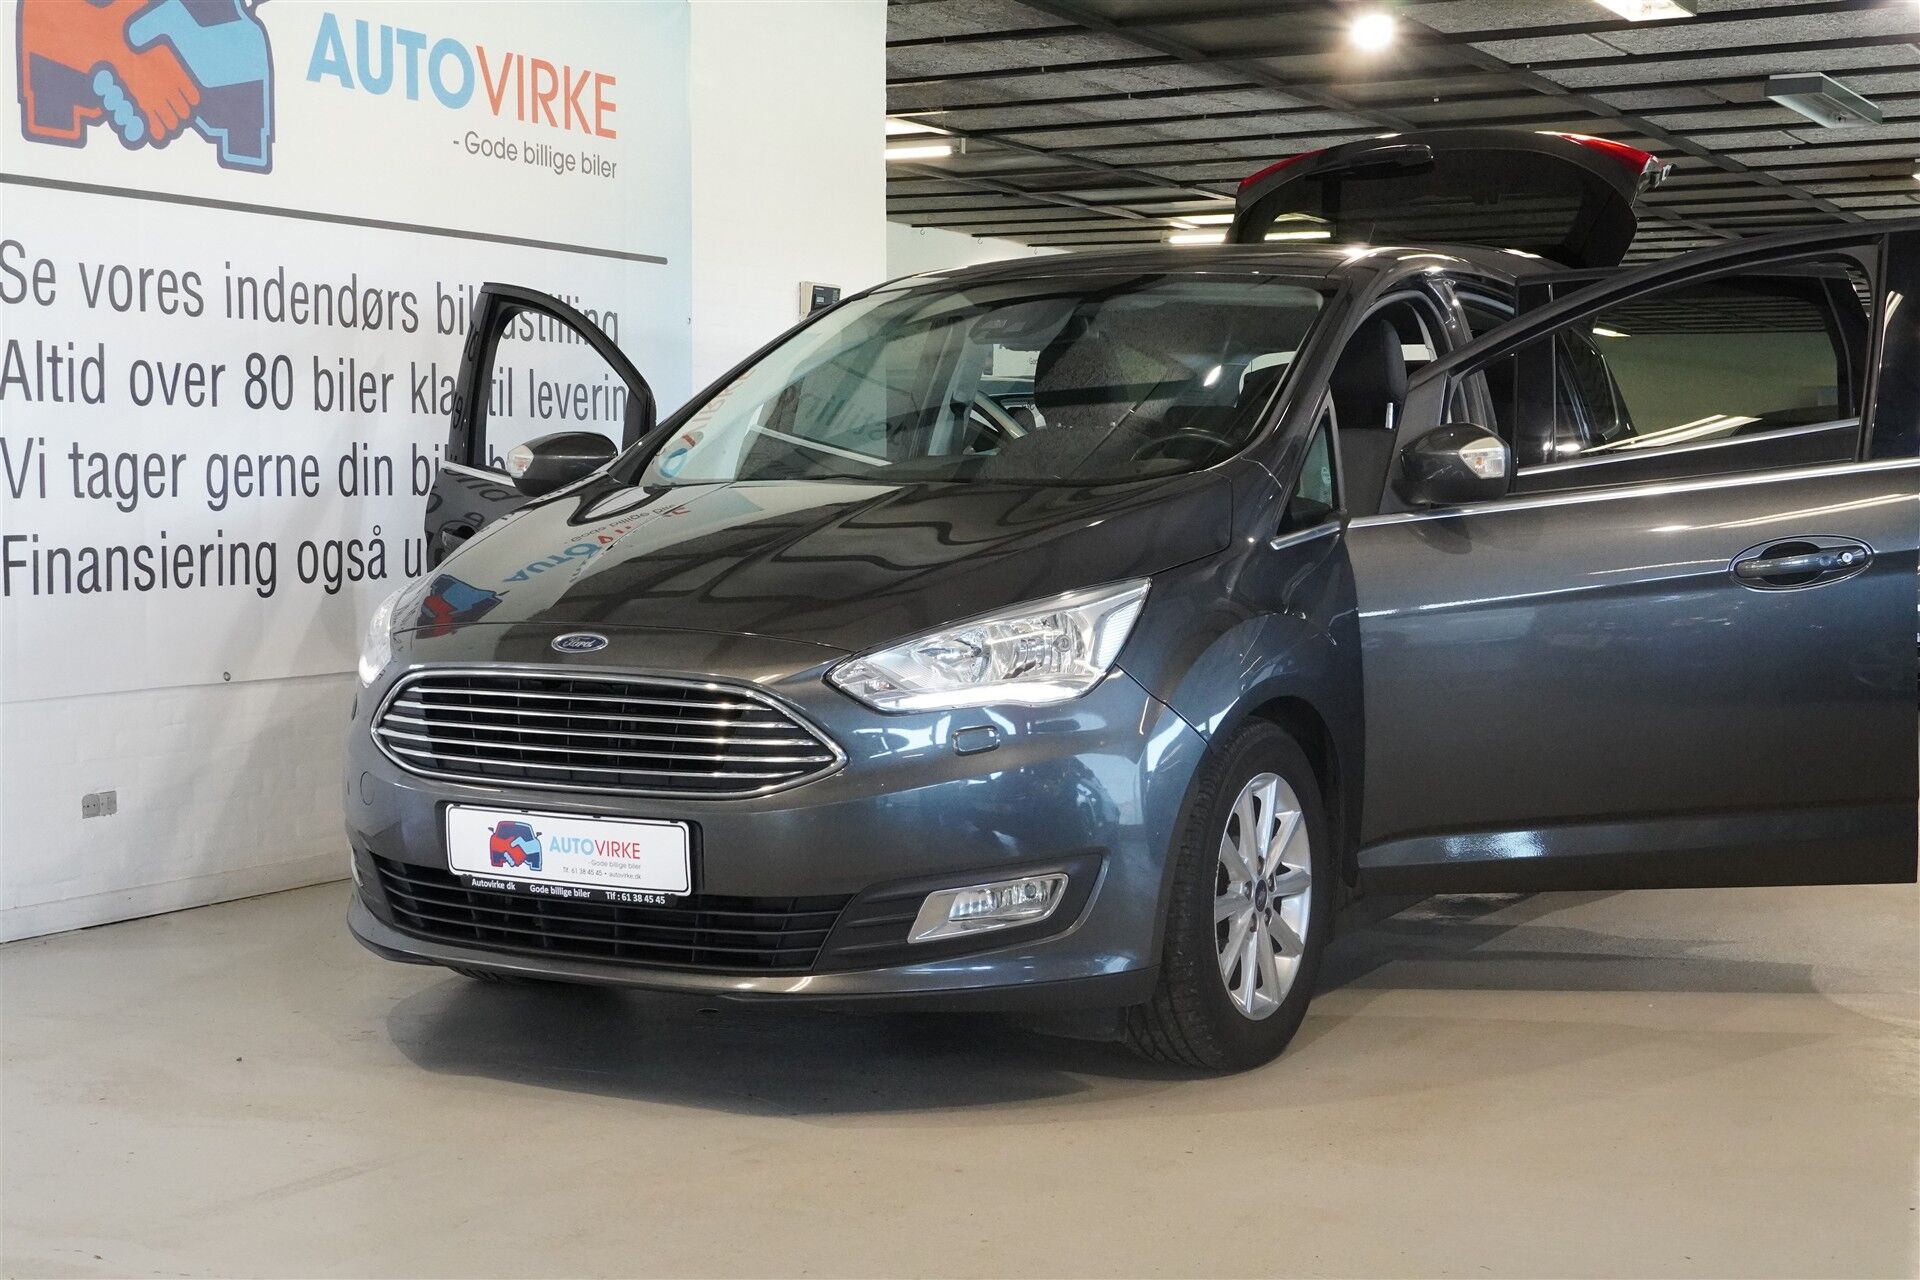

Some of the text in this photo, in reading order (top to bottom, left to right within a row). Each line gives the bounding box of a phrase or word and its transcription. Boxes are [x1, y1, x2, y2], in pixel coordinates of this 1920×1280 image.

[306, 12, 617, 140] AUTOVIRKE
[465, 131, 518, 161] Gode
[524, 143, 576, 175] billige
[582, 152, 617, 179] biler
[0, 239, 57, 307] Se
[79, 262, 204, 317] vores
[225, 261, 419, 334] indendørs
[0, 339, 105, 405] Altid
[130, 359, 226, 407] over
[245, 352, 293, 410] 80
[313, 355, 394, 413] biler
[410, 361, 455, 416] kla
[488, 366, 513, 417] til
[529, 368, 628, 422] leverin
[0, 437, 46, 499] Vi
[68, 441, 187, 513] tager
[206, 453, 320, 512] gerne
[338, 441, 393, 497] din
[3, 529, 277, 598] Finansiering
[297, 525, 387, 595] også
[549, 836, 641, 860] AUTOVIRKE
[595, 869, 603, 877] 45
[609, 871, 641, 879] autovirke.dk
[471, 878, 505, 890] Autovirke
[506, 881, 516, 890] dk
[529, 884, 549, 894] Gode
[550, 886, 572, 897] billige
[573, 888, 591, 898] biler
[621, 893, 631, 902] 61
[633, 894, 643, 902] 38
[644, 895, 654, 904] 45
[655, 896, 666, 904] 45
